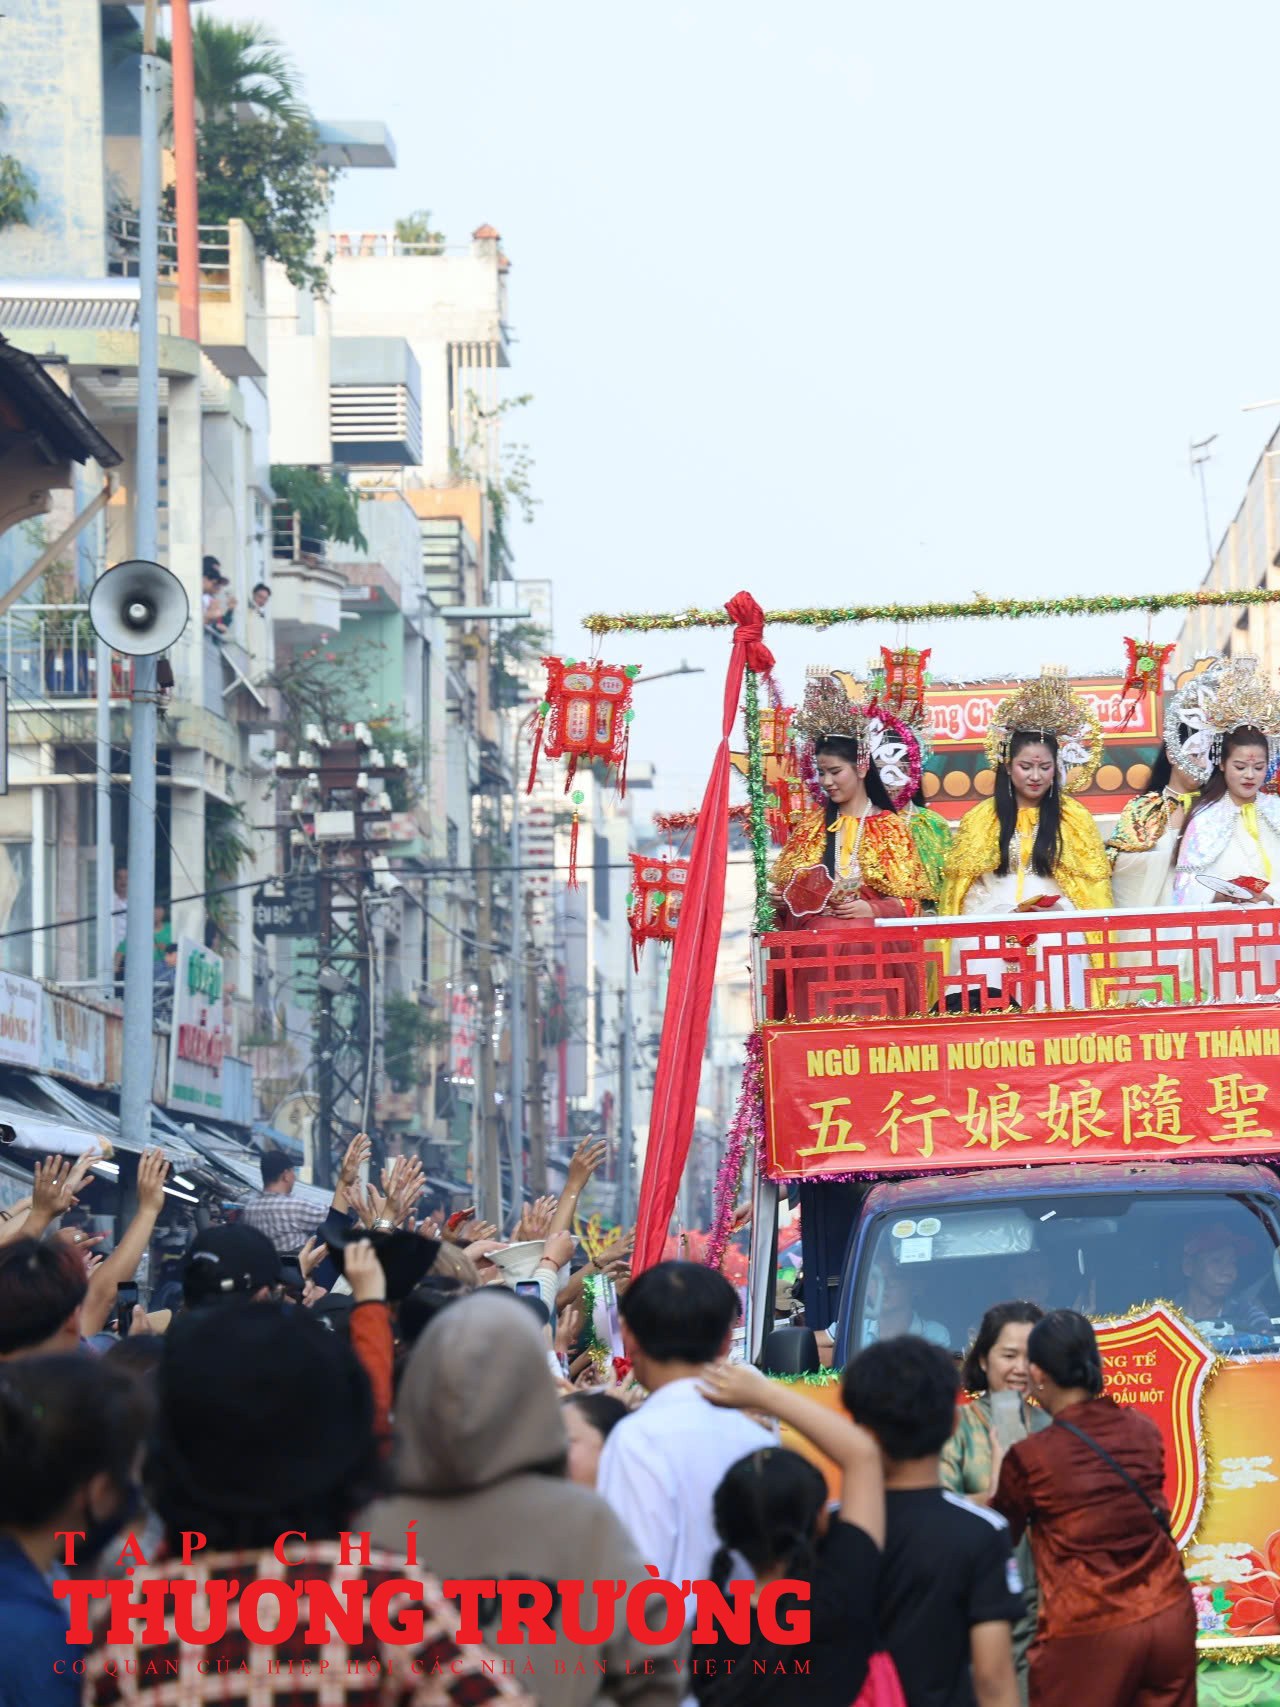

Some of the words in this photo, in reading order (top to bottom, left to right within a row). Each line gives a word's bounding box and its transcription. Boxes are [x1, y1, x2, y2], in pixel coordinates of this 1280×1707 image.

[807, 1044, 860, 1077] NGŨ
[868, 1042, 939, 1074] HÀNH
[947, 1036, 1035, 1070] NƯƠNG
[1043, 1032, 1132, 1065] NƯƠNG
[1140, 1029, 1188, 1061] TÙY
[1195, 1026, 1280, 1059] THÁNH
[1132, 1349, 1157, 1368] TẾ
[1139, 1387, 1166, 1406] MỘT
